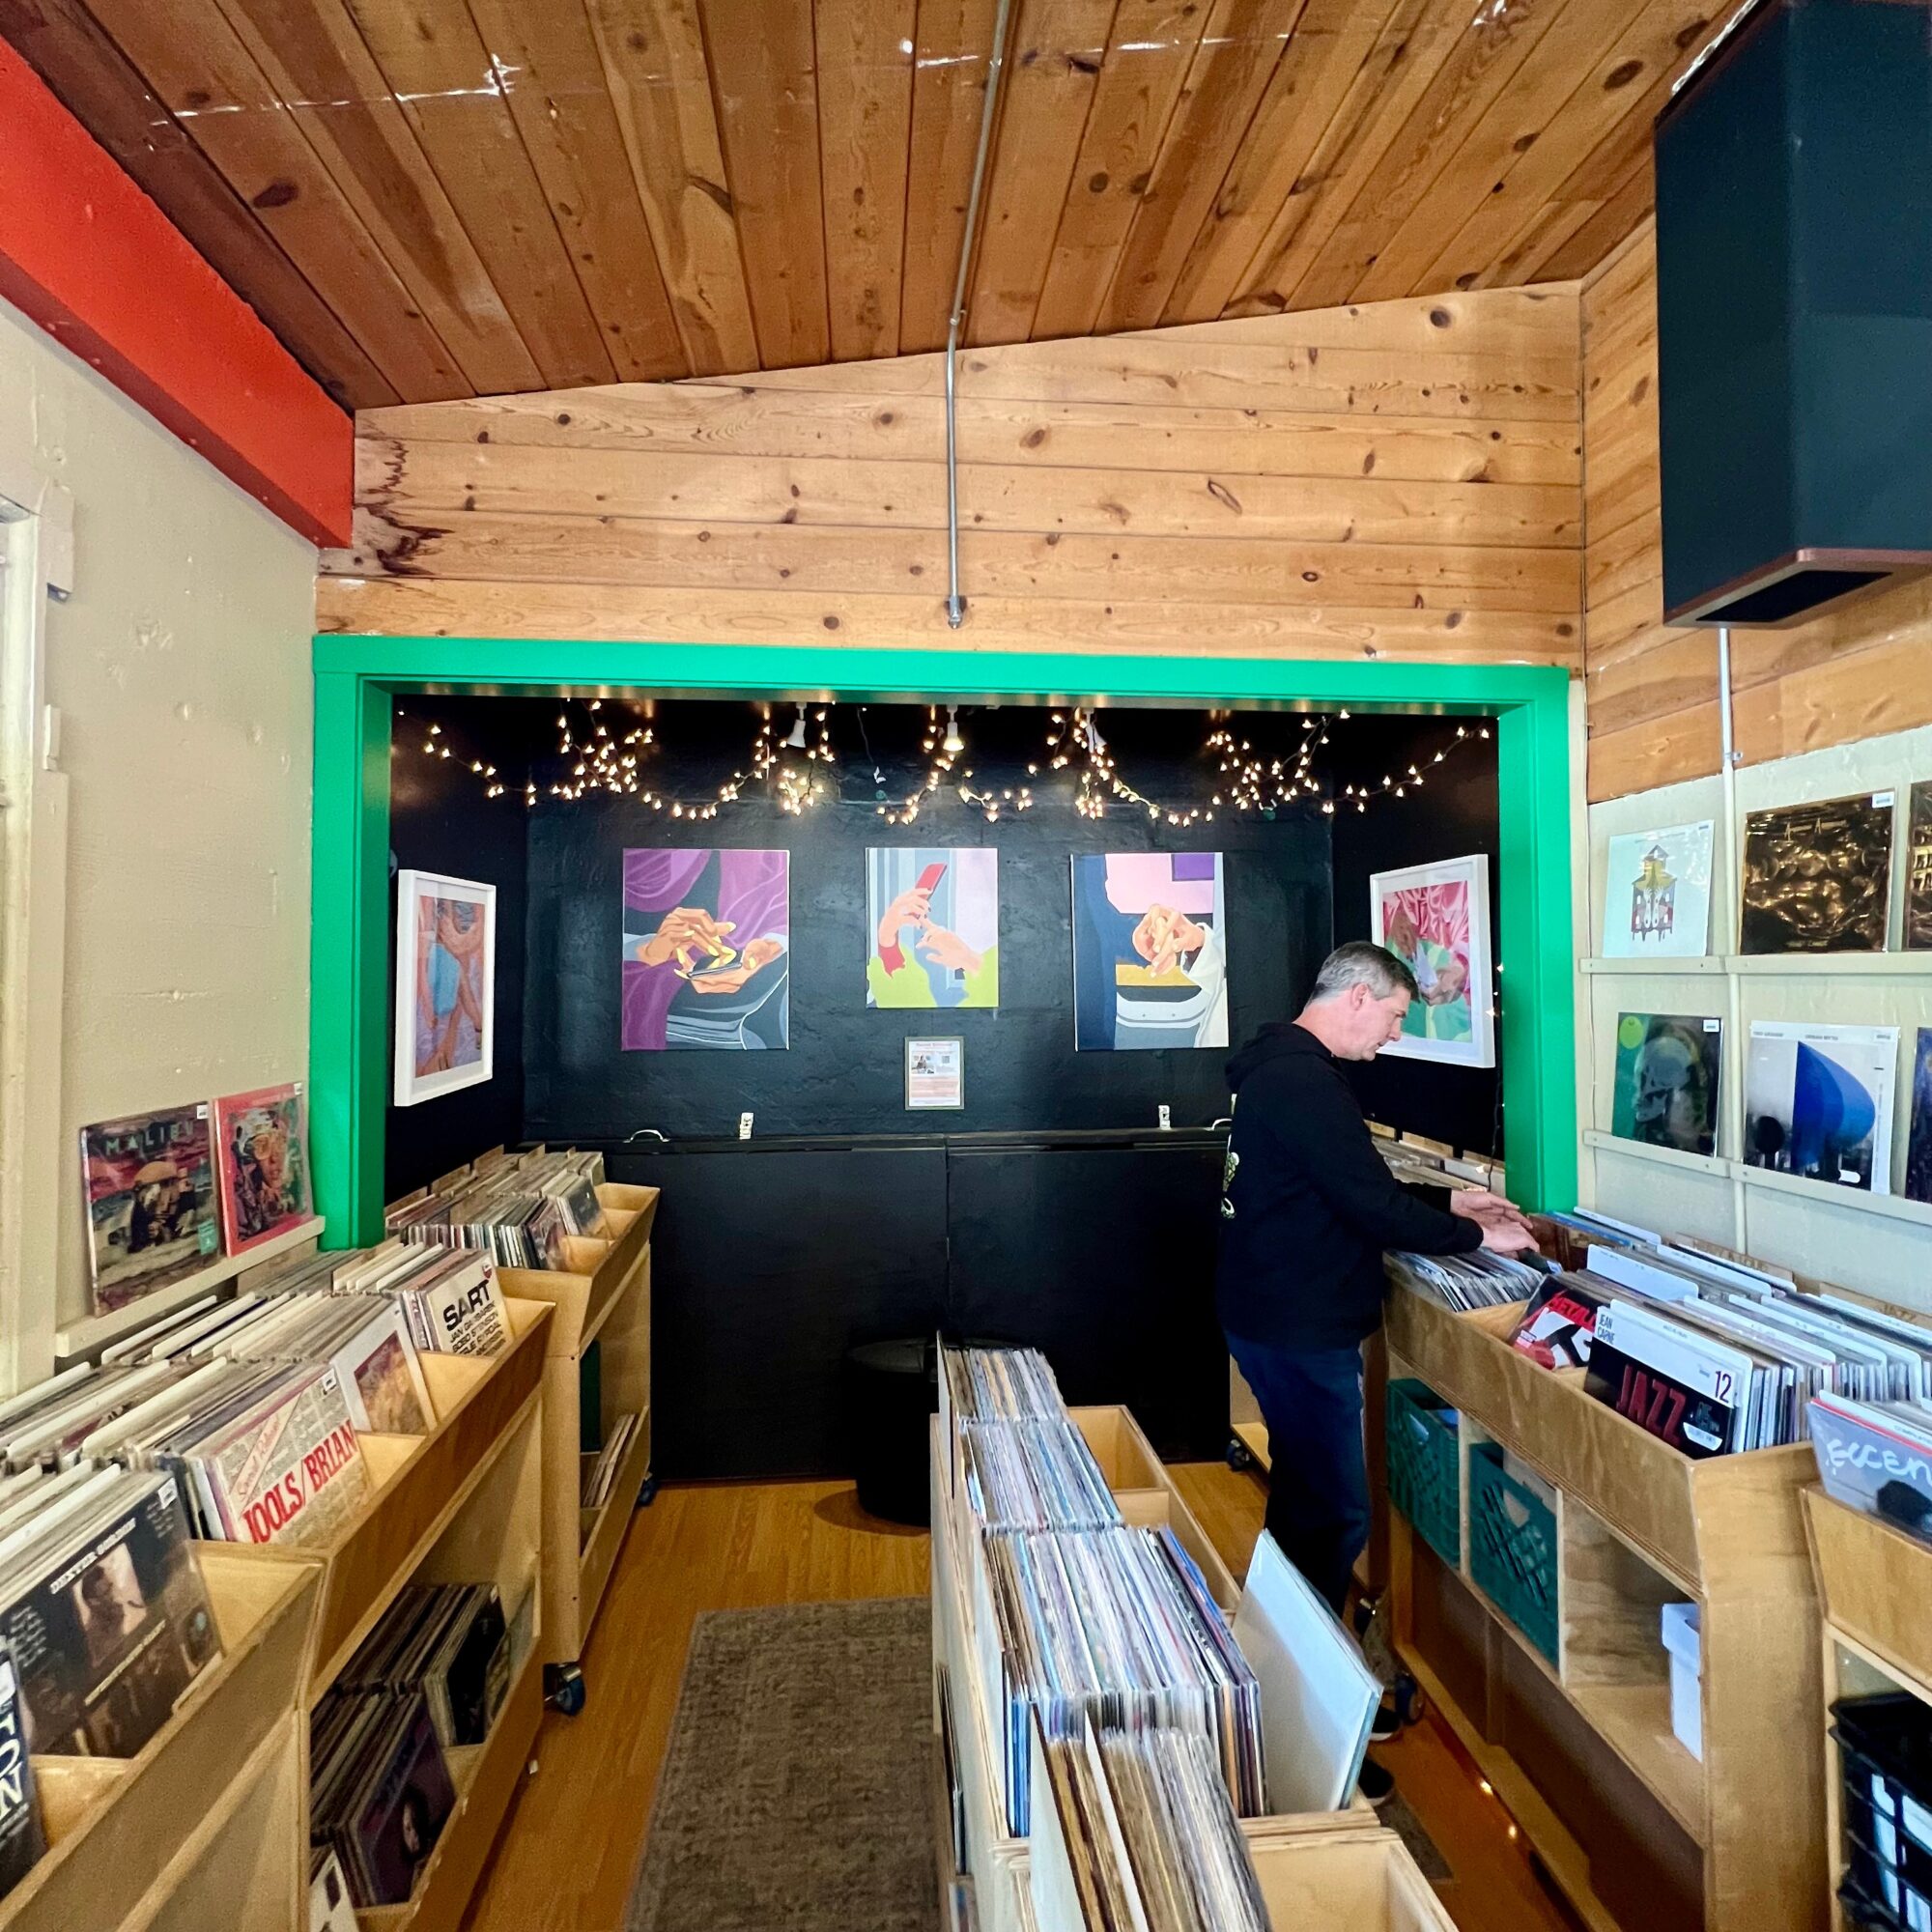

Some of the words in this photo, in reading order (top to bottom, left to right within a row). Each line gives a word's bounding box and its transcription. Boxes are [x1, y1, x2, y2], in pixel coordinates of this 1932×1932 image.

[442, 1279, 490, 1331] SART
[1599, 1314, 1612, 1329] JEAN
[1616, 1363, 1687, 1447] JAZZ
[1715, 1370, 1732, 1404] 12
